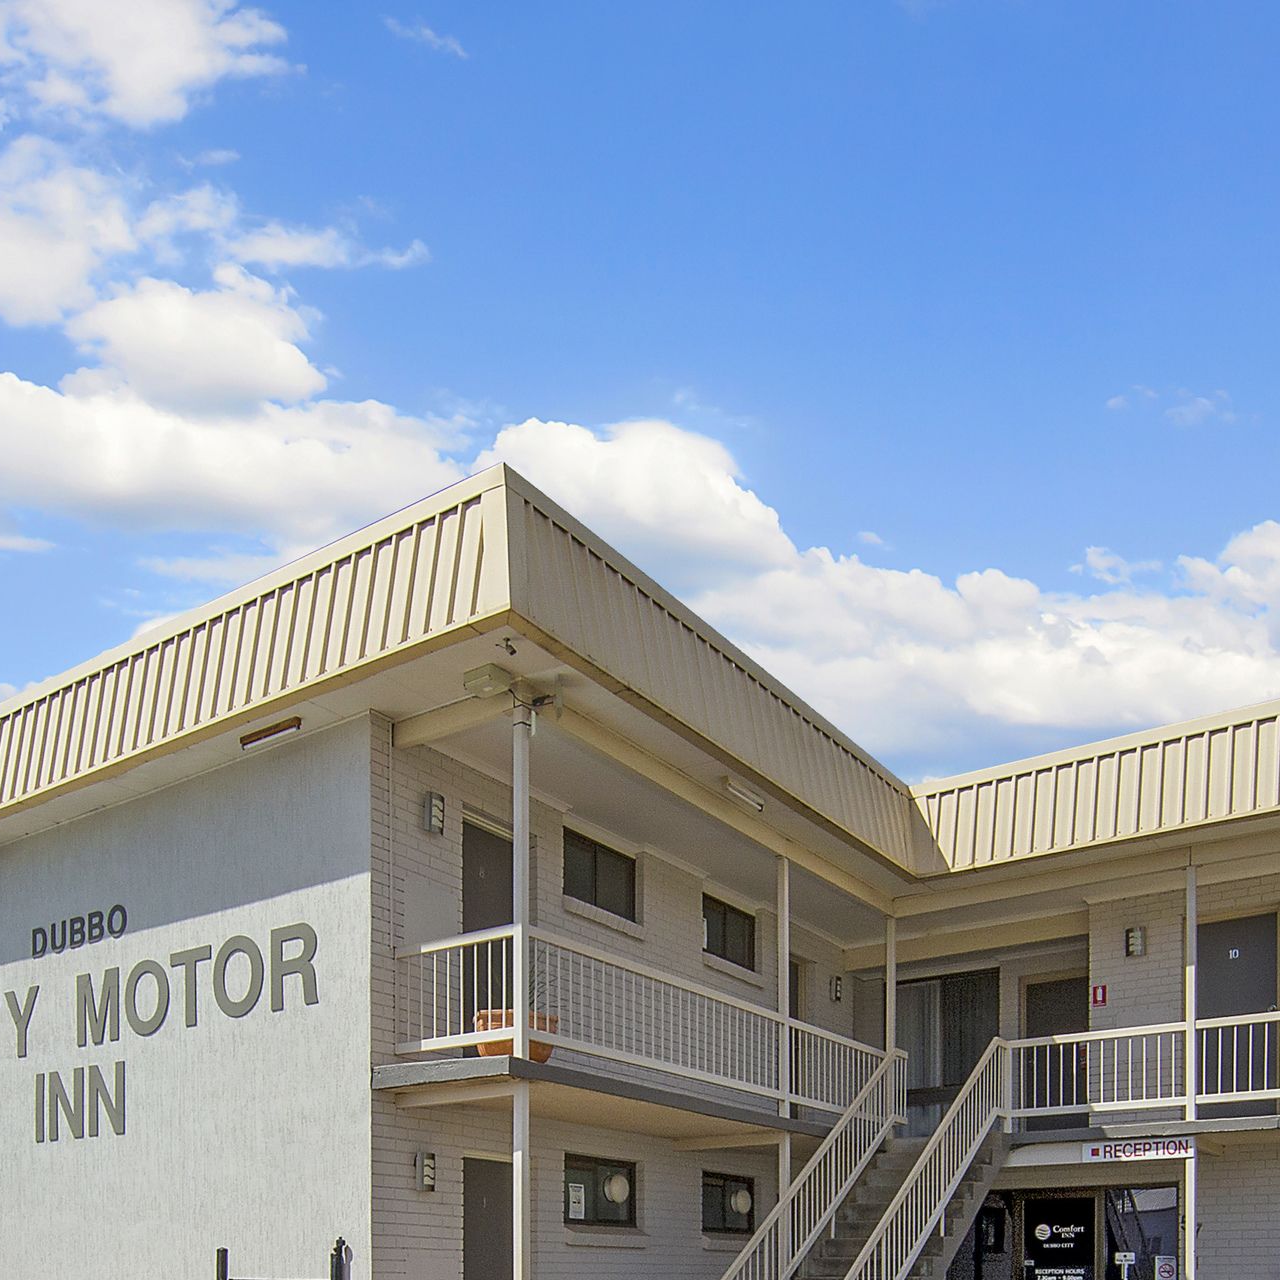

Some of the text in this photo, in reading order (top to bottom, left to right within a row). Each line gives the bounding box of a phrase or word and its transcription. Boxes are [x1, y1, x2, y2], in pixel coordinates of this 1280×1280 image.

[31, 904, 128, 959] DUBBO
[1229, 949, 1239, 960] 10
[75, 922, 320, 1048] MOTOR
[34, 1060, 126, 1143] INN
[1103, 1139, 1189, 1159] RECEPTION
[1052, 1224, 1085, 1233] Comfort
